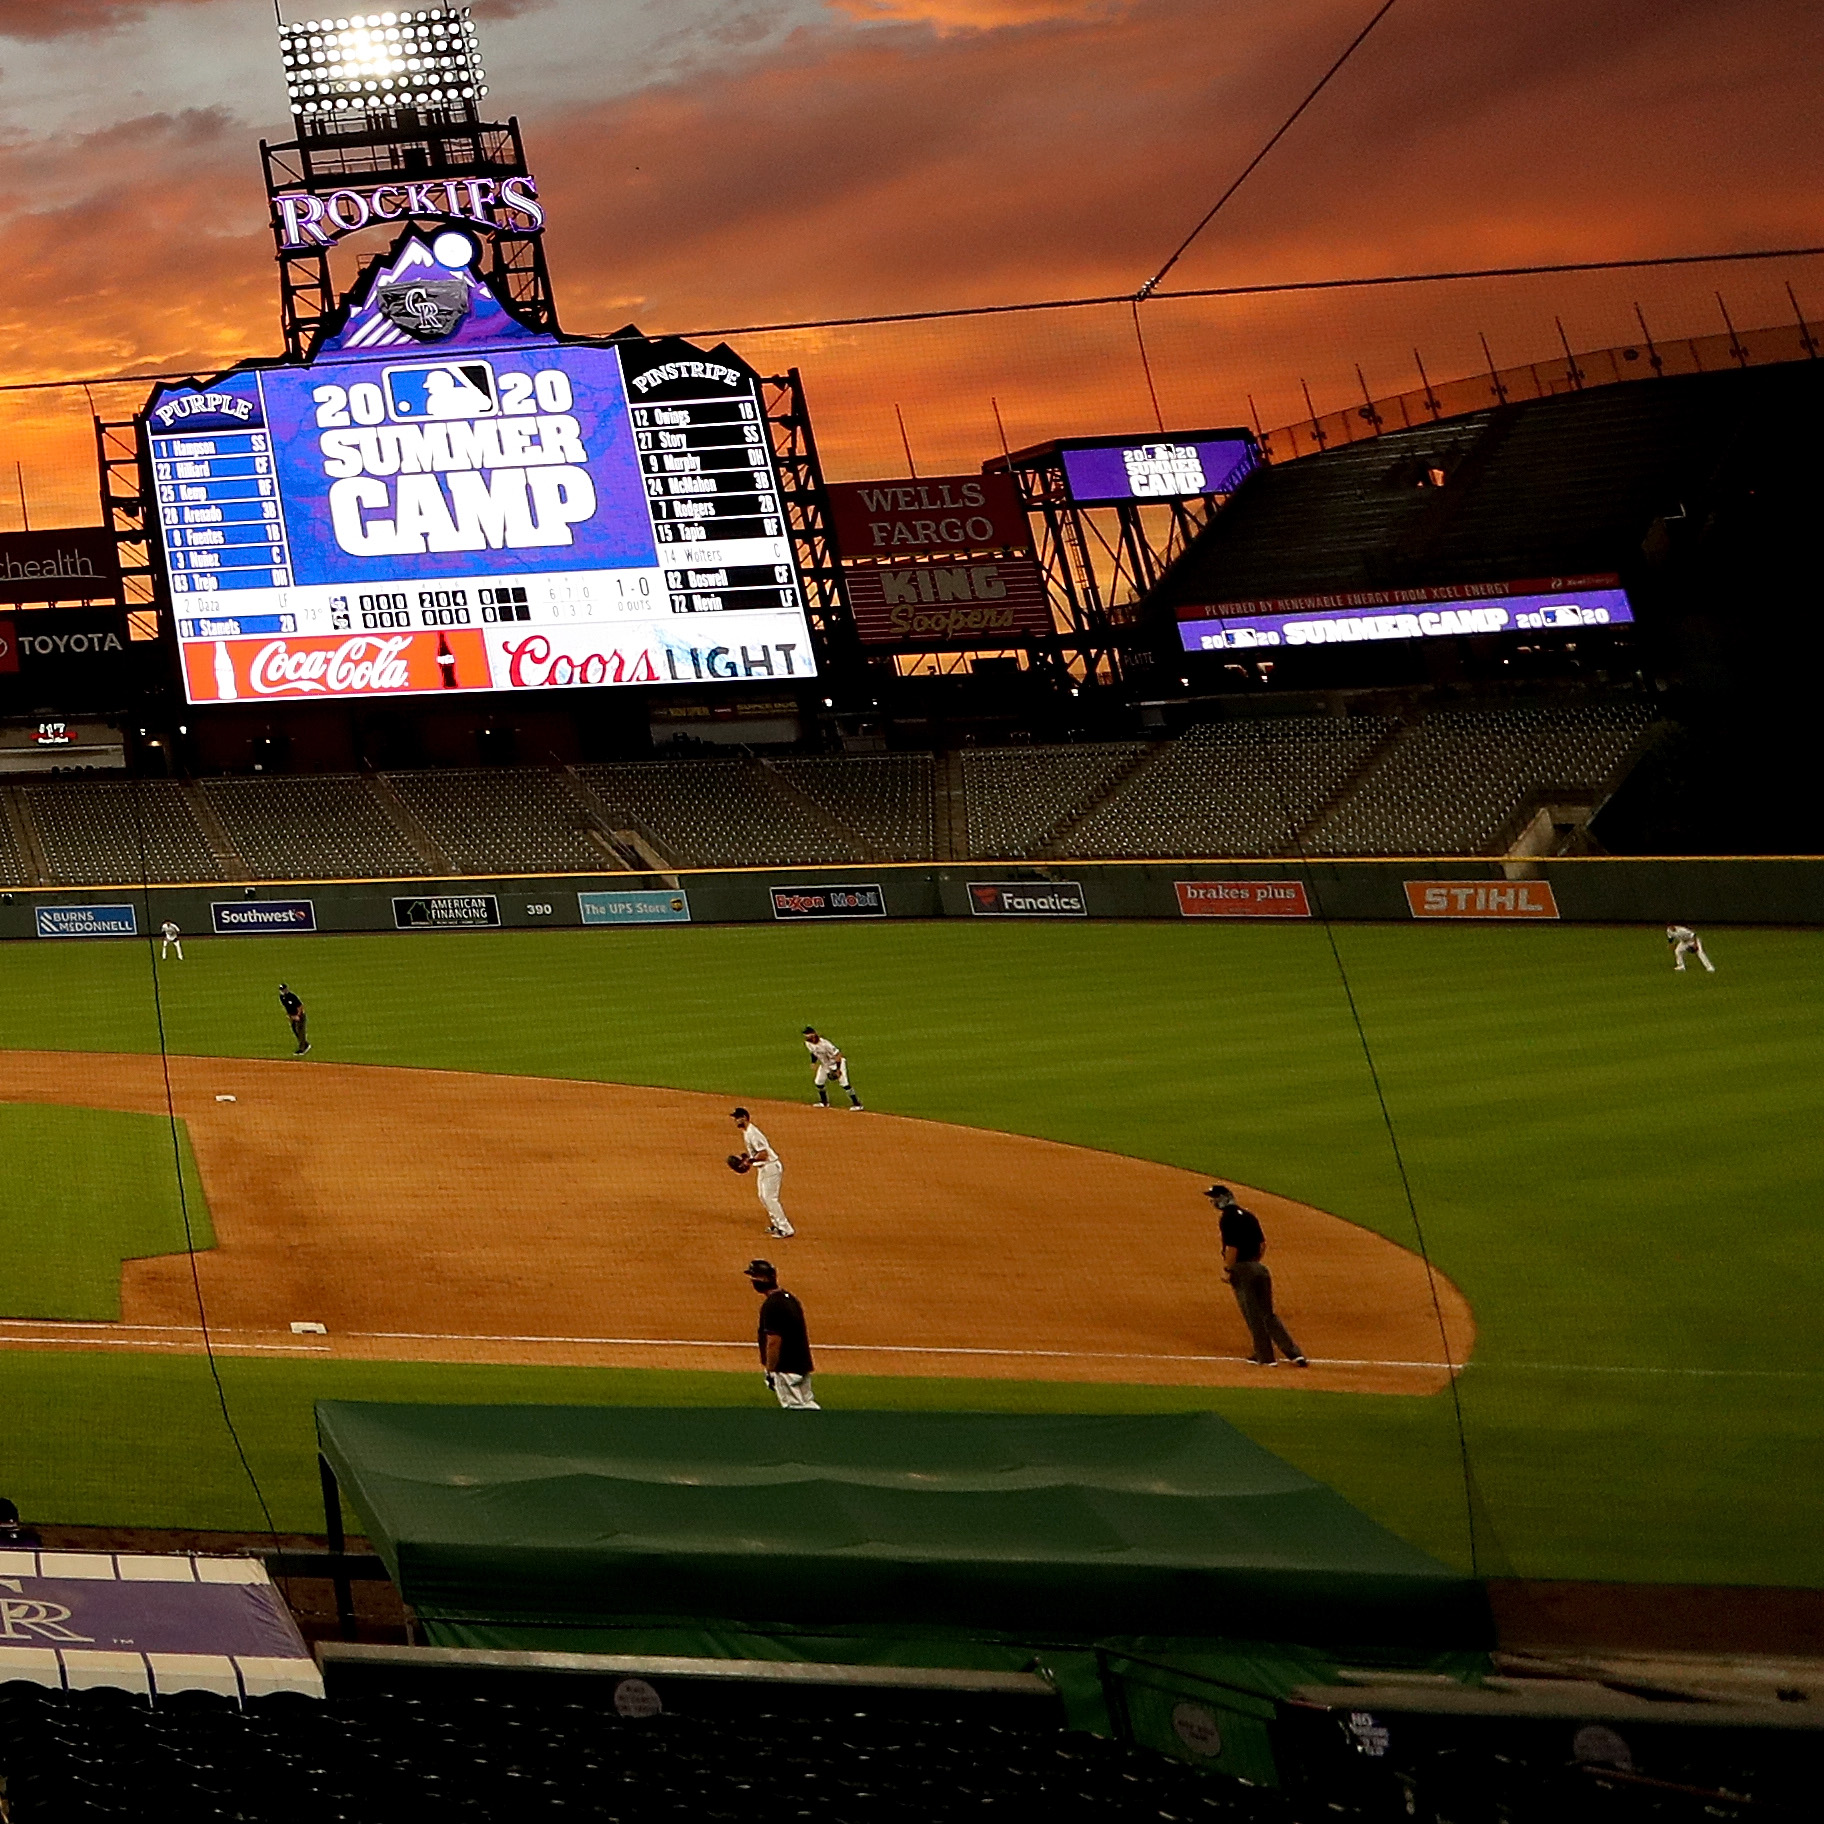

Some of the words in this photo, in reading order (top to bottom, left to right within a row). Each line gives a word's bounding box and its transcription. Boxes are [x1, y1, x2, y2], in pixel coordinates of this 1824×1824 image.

[272, 176, 546, 250] ROCKIES
[632, 362, 740, 393] PINSTRIPE
[156, 394, 253, 426] PURPLE
[635, 410, 649, 426] 12
[161, 442, 167, 457] 1
[251, 435, 266, 451] SS
[319, 414, 589, 478] SUMMER
[639, 433, 652, 449] 27
[659, 432, 686, 448] Story
[743, 426, 759, 442] SS
[158, 463, 171, 479] 22
[650, 456, 658, 472] 9
[663, 454, 700, 471] Murphy
[1126, 459, 1202, 475] SUMMER
[161, 485, 174, 501] 25
[179, 485, 207, 501] Kemp
[648, 479, 663, 495] 24
[668, 477, 717, 494] McMahon
[1129, 473, 1206, 497] CAMP
[857, 483, 985, 512] WELLS
[328, 464, 596, 556] CAMP
[659, 502, 666, 518] 7
[673, 500, 715, 519] Rodgers
[658, 526, 673, 541] 15
[677, 523, 706, 541] Tapia
[869, 517, 994, 546] FARGO
[177, 552, 184, 568] 3
[272, 547, 281, 563] C
[665, 550, 676, 563] 14
[684, 549, 722, 562] Wolters
[774, 544, 780, 557] C
[688, 570, 728, 587] Boswell
[880, 566, 1006, 604] KING
[185, 599, 189, 612] 2
[198, 598, 219, 612] Daza
[279, 593, 287, 607] LF
[627, 600, 651, 611] OUTS
[672, 596, 688, 612] 72
[693, 594, 723, 611] Nevin
[1260, 601, 1273, 612] BY
[1278, 596, 1344, 611] RENEWABLE
[1348, 592, 1389, 605] ENERGY
[1395, 588, 1427, 602] FROM
[1433, 585, 1461, 599] XCEL
[1464, 582, 1510, 596] ENERGY
[890, 604, 1014, 641] Soopers
[19, 633, 123, 654] TOYOTA
[253, 634, 413, 692] Coca-Cola
[502, 635, 660, 685] Coors
[666, 643, 796, 680] LIGHT
[430, 898, 486, 909] AMERICAN
[776, 894, 824, 912] Exxon
[831, 892, 877, 907] Mobil
[1002, 893, 1081, 910] Fanatics
[1186, 885, 1250, 900] brakes
[1256, 885, 1295, 903] plus
[1423, 886, 1544, 911] STIHL
[53, 911, 94, 921] BURNS
[221, 909, 295, 924] Southwest
[431, 908, 488, 920] FINANCING
[527, 904, 553, 916] 390
[584, 904, 606, 915] The
[609, 903, 633, 914] UPS
[637, 903, 666, 914] Store
